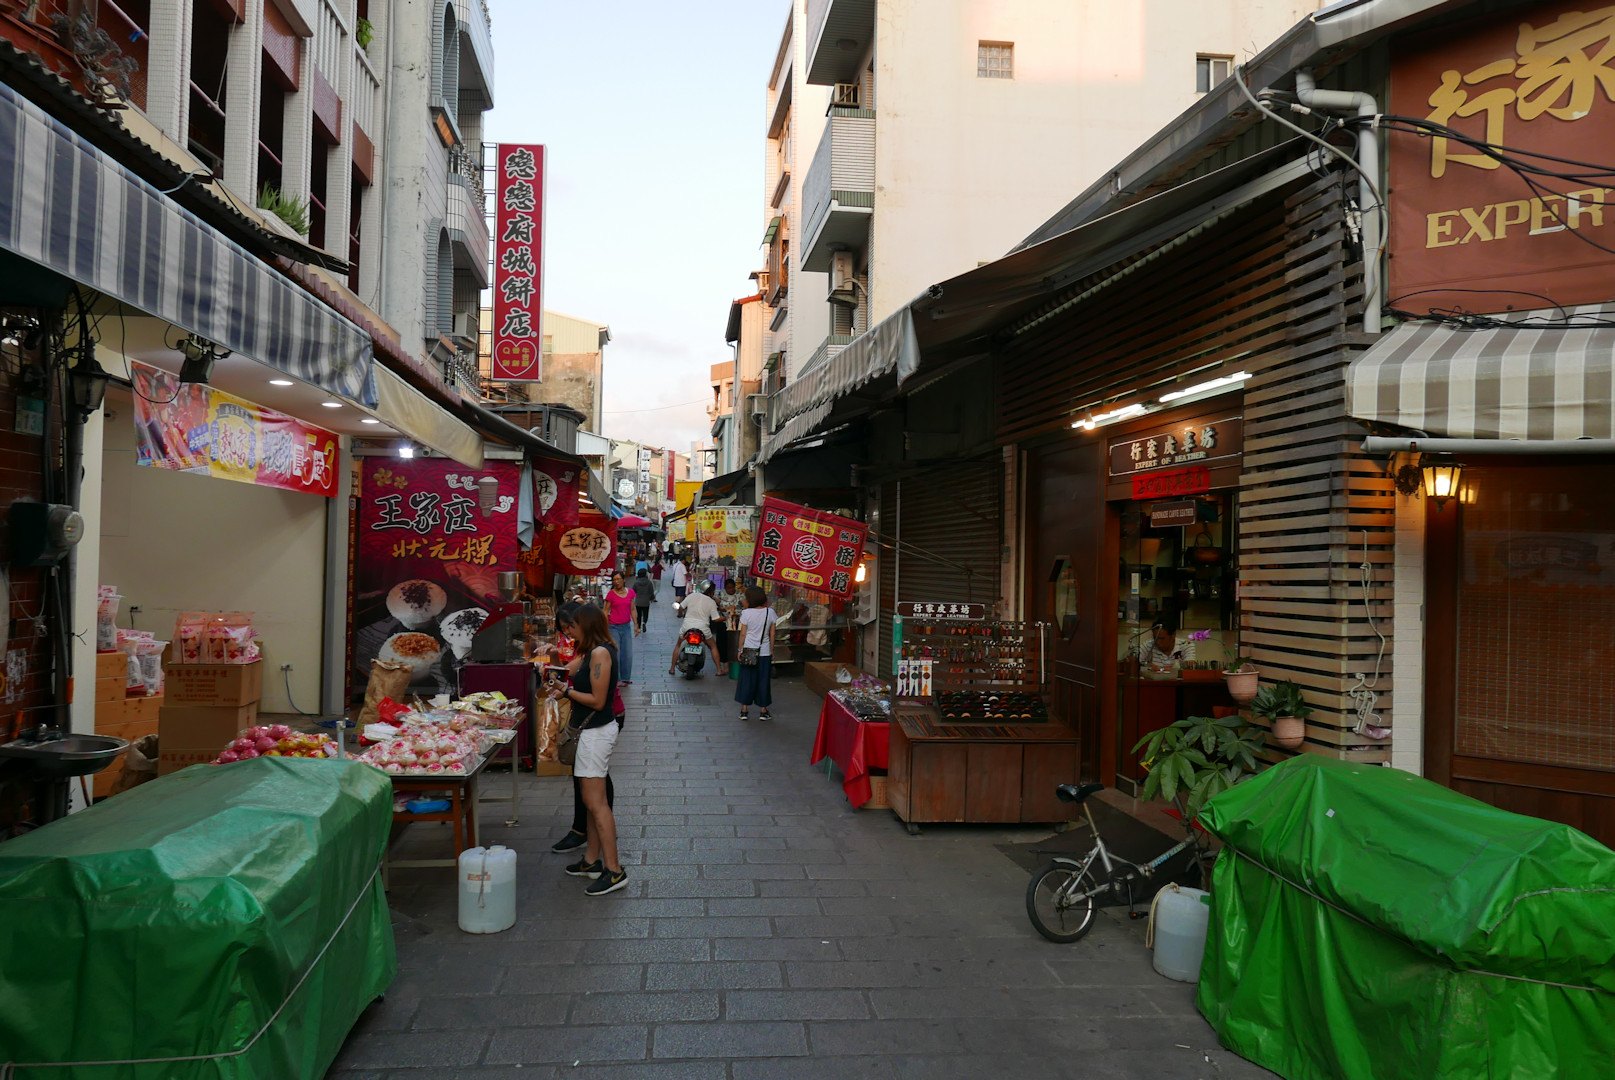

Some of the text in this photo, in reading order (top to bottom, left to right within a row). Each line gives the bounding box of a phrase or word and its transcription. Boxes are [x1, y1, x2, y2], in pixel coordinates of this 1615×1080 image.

[1425, 187, 1615, 249] EXPER
[501, 148, 537, 338] 戀戀府城餅店
[1130, 427, 1216, 460] 行家皮革坊
[1135, 451, 1207, 470] EXPERT OF LEATHER
[371, 491, 478, 535] 王家庄
[391, 534, 499, 566] 狀元粿
[562, 532, 608, 551] 王家庄
[757, 528, 782, 575] 金桔
[794, 541, 820, 565] 咳
[913, 603, 970, 614] 行家皮革坊
